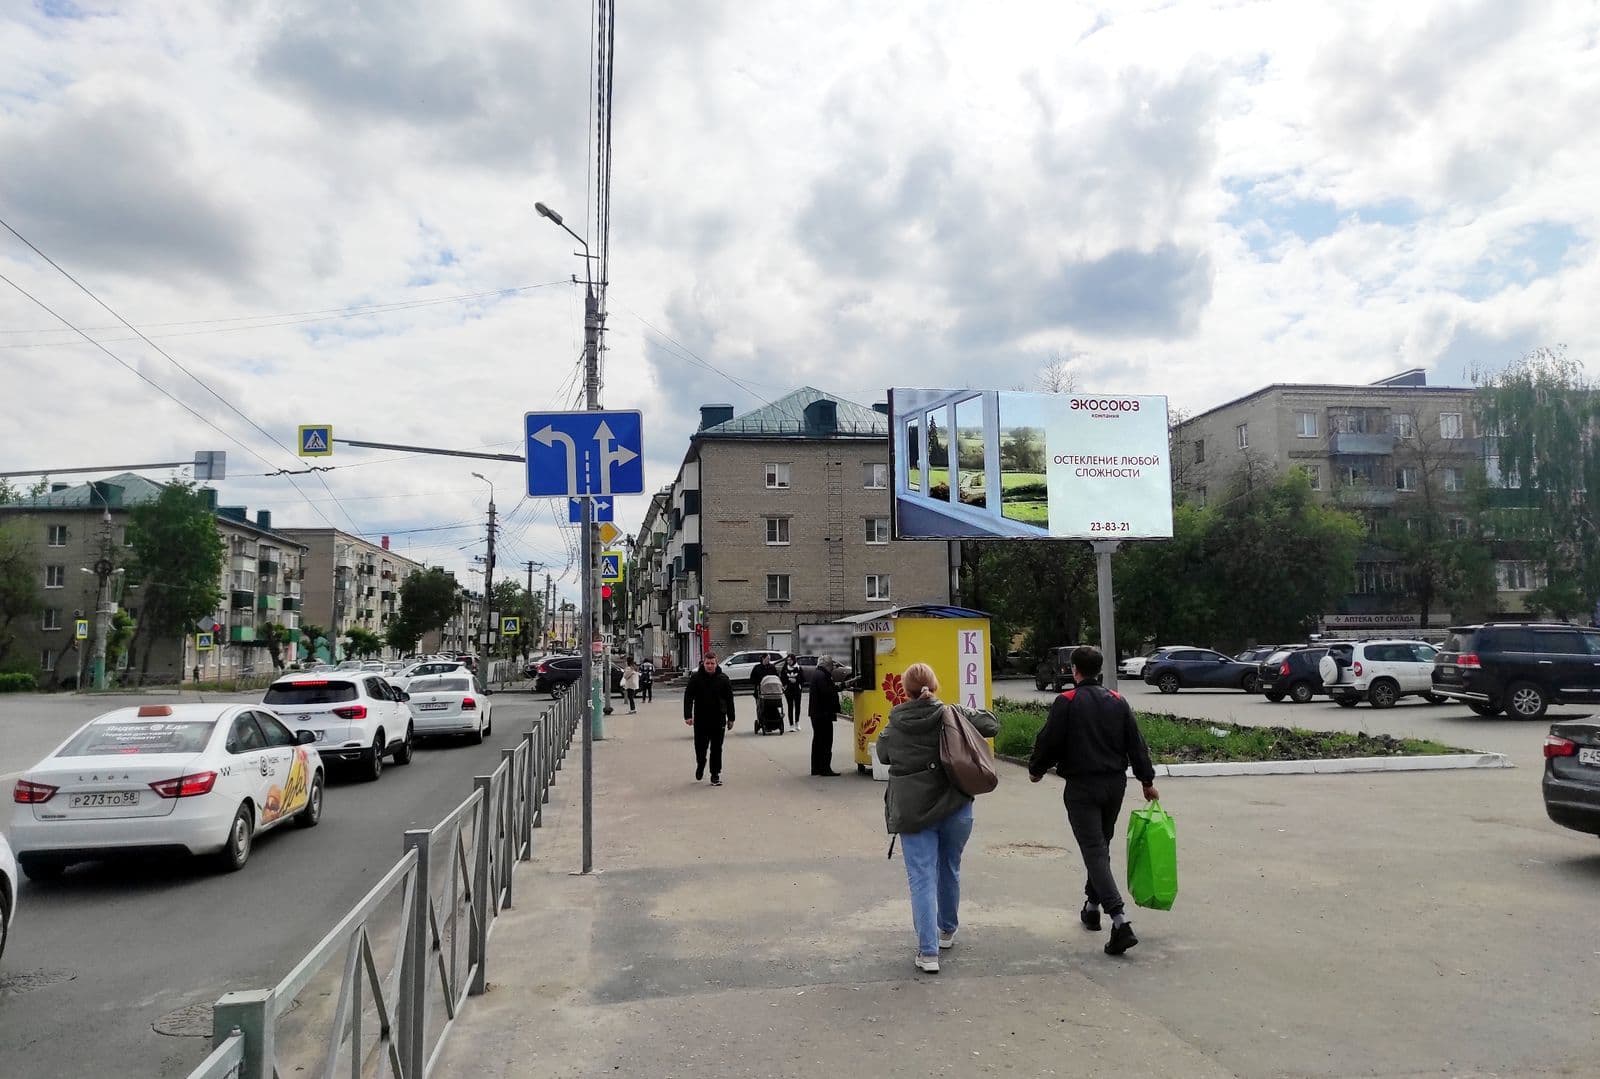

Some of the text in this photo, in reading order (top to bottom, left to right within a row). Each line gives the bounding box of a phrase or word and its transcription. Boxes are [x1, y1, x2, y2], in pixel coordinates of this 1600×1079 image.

[1070, 399, 1140, 412] ЭКОСОЮЗ
[1053, 454, 1160, 466] ОСТЕКЛЕНИЕ ЛЮБОЙ
[1075, 468, 1140, 478] СЛОЖНОСТИ
[1090, 522, 1130, 531] 23-83-21
